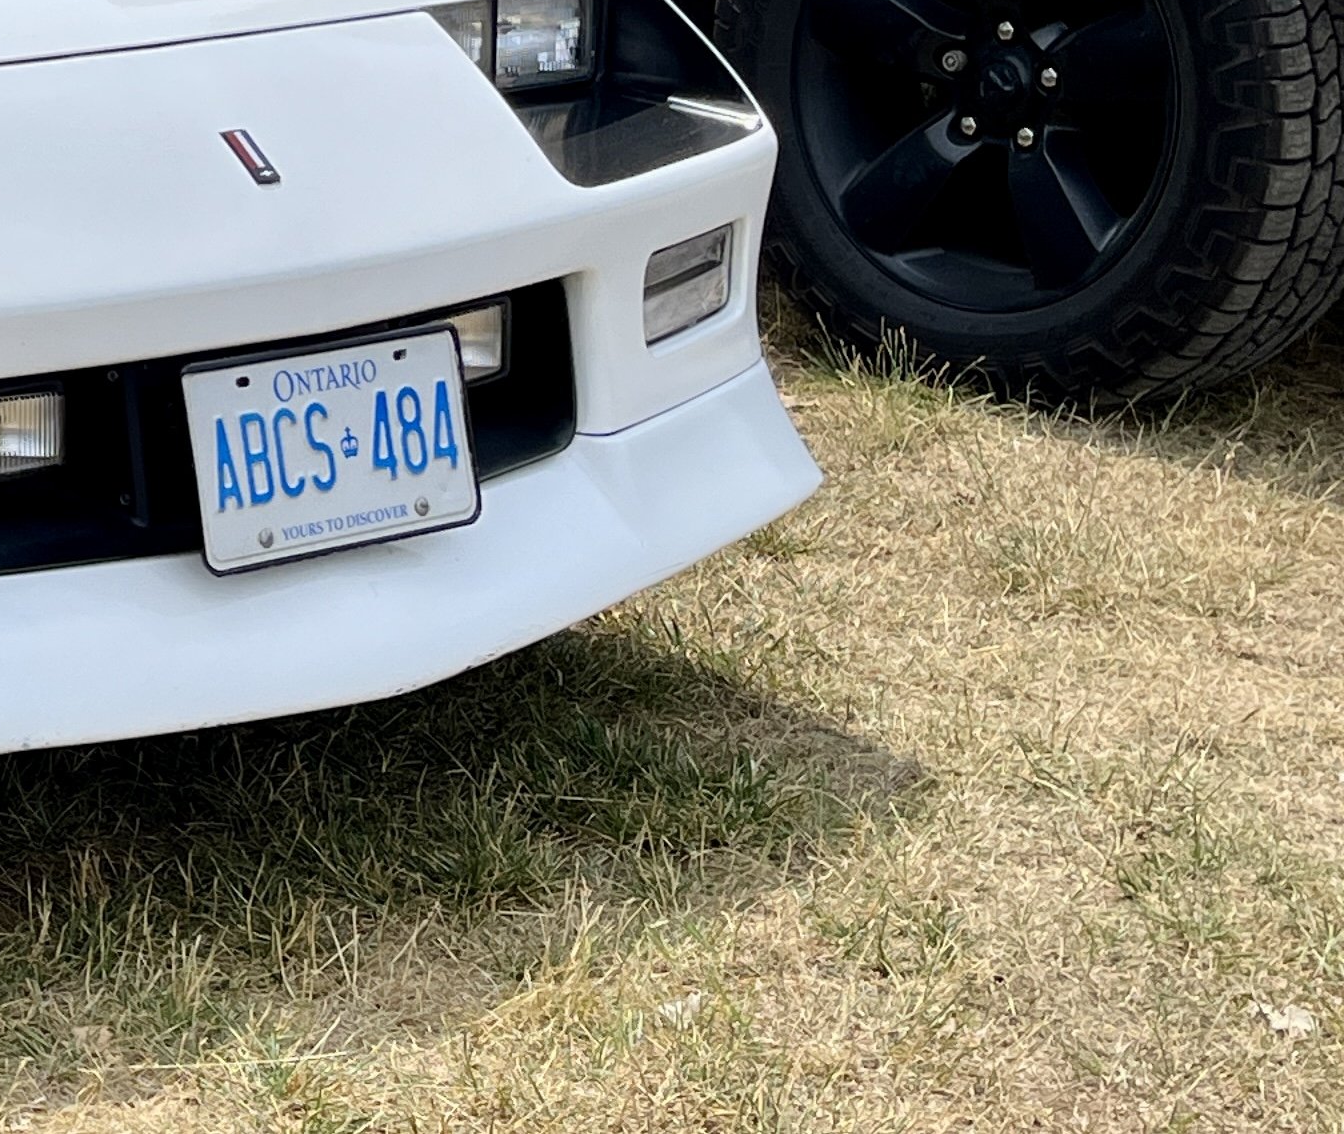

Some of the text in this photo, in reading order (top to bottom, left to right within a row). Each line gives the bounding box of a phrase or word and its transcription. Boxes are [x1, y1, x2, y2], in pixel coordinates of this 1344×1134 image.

[273, 360, 377, 402] ONTARIO
[215, 380, 458, 512] ABCS 484
[281, 504, 409, 541] YOURS TO DISCOVER
